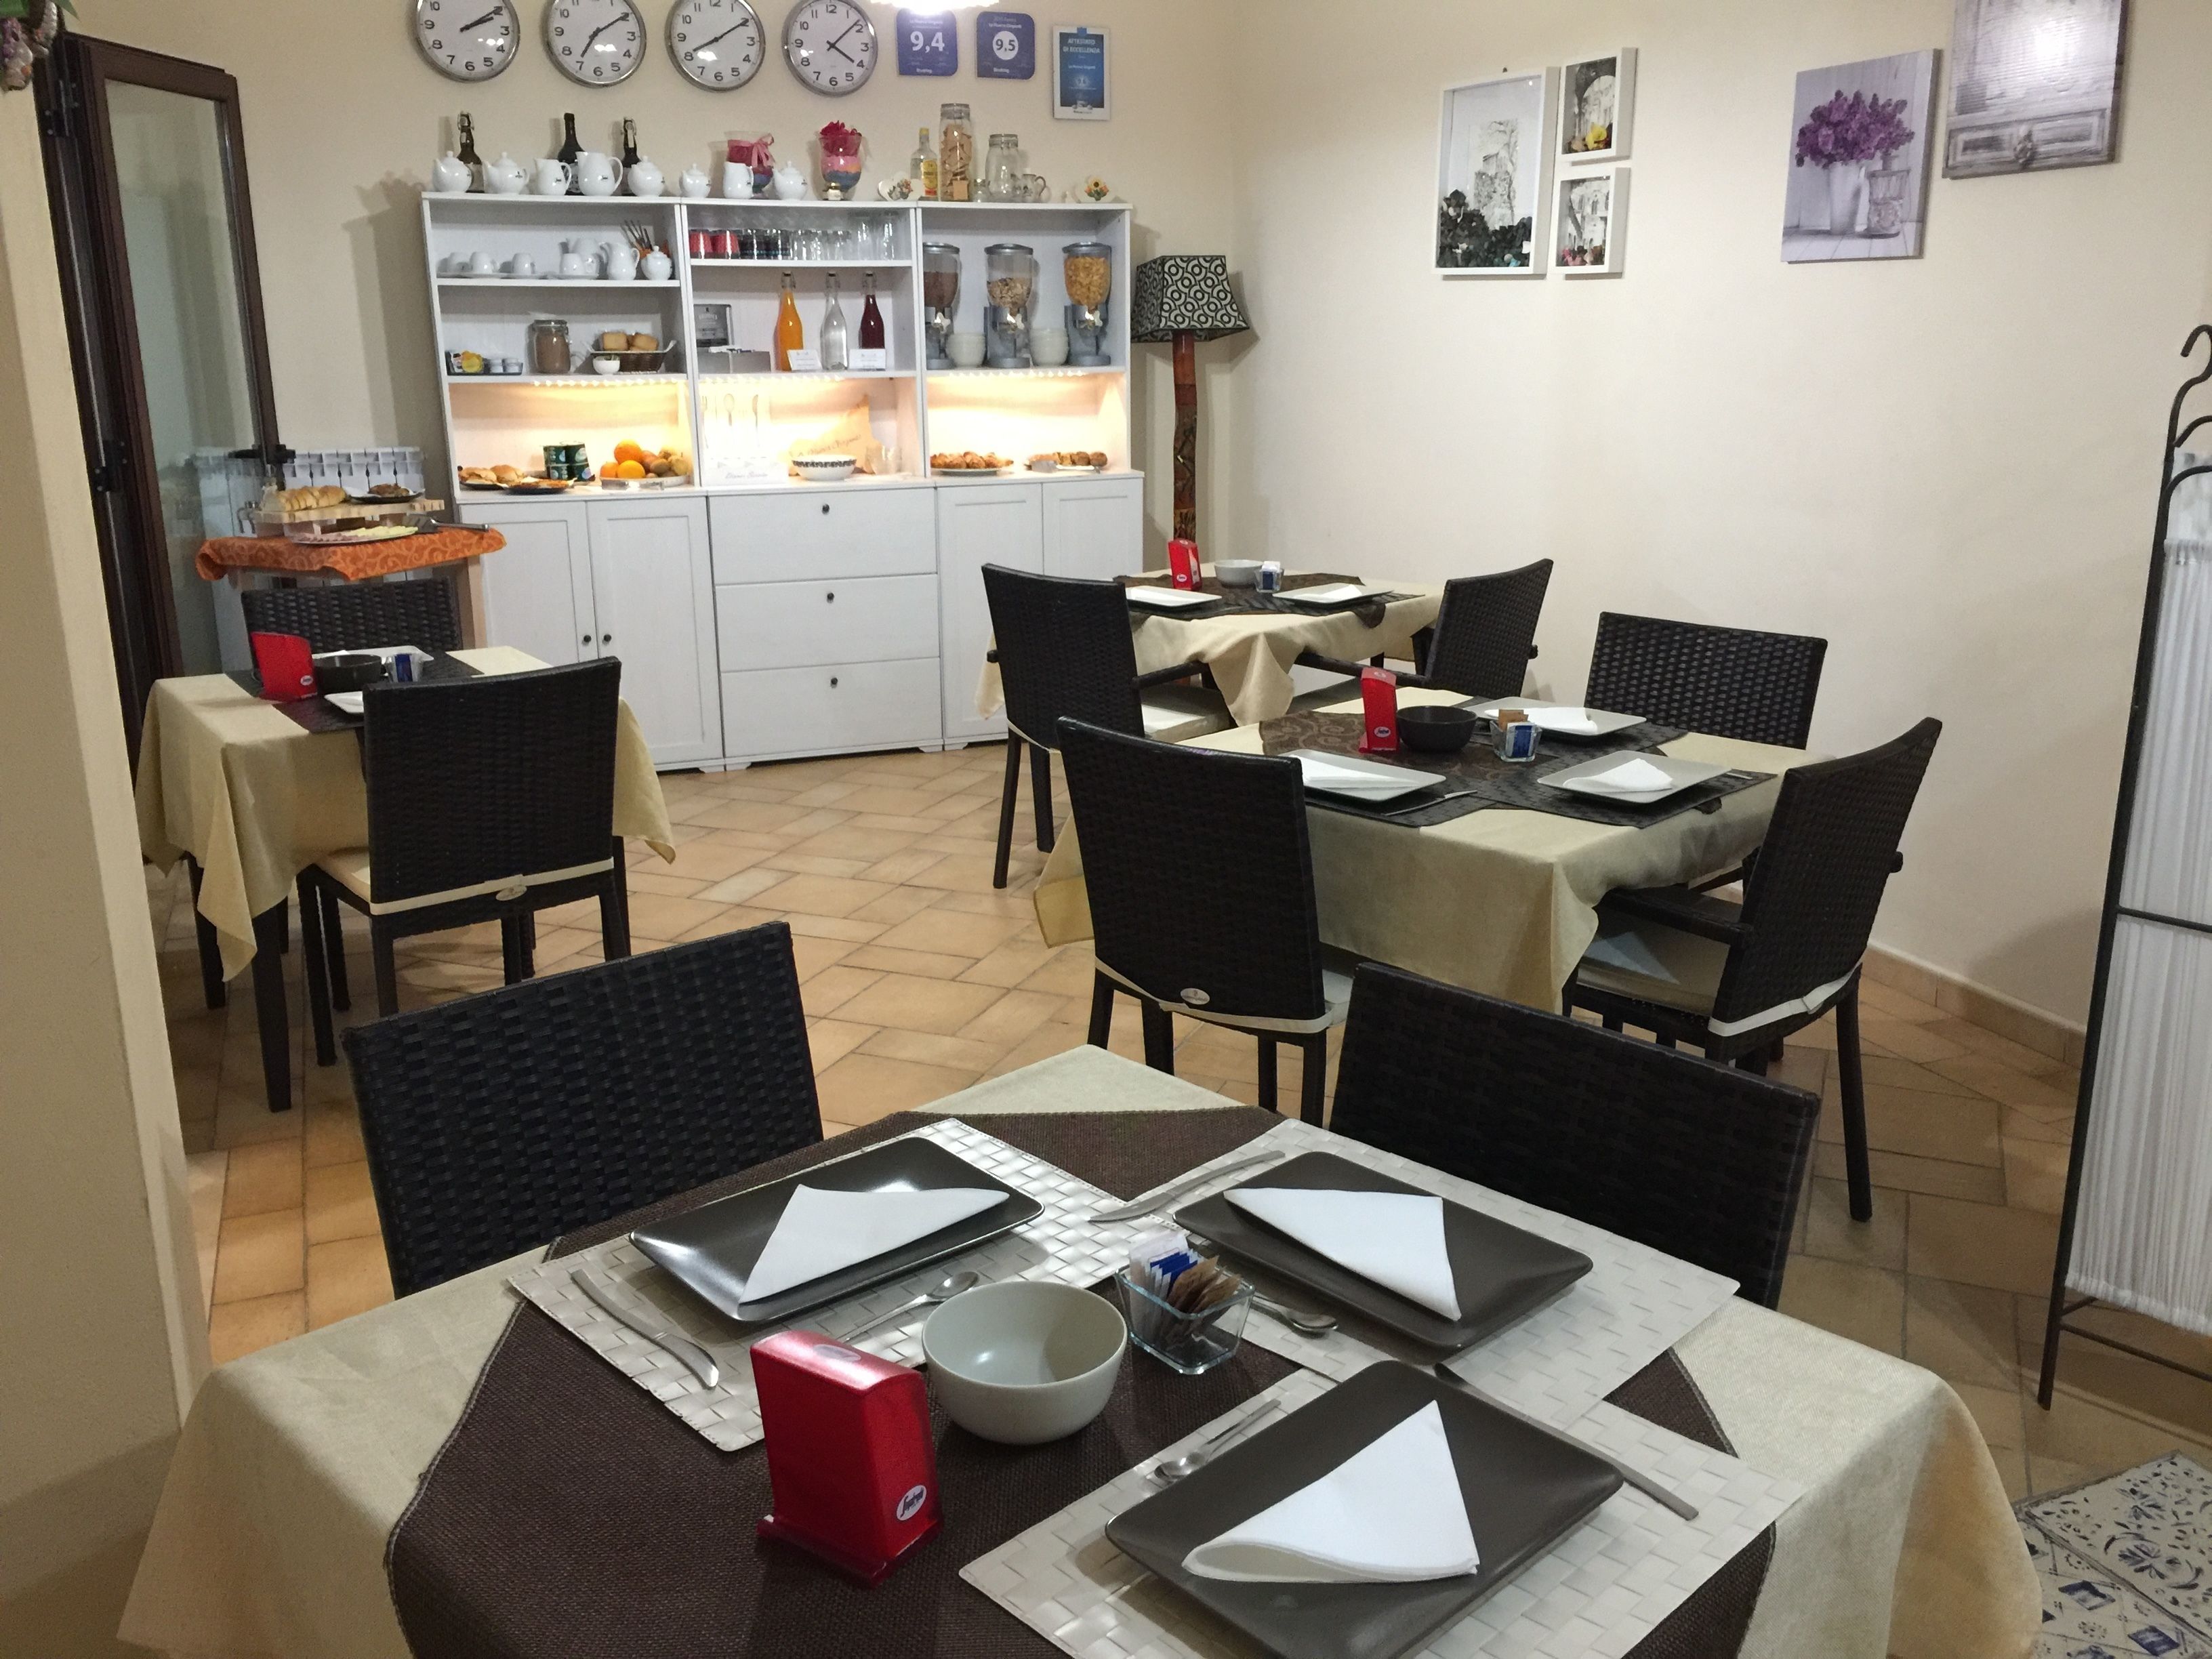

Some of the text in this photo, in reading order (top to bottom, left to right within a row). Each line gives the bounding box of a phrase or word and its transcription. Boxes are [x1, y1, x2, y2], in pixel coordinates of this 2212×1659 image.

[430, 1, 440, 11] 10
[694, 3, 701, 12] 11
[731, 3, 734, 12] 1
[826, 4, 837, 14] 12
[560, 9, 569, 18] 10
[811, 9, 818, 18] 11
[846, 9, 849, 19] 1
[682, 15, 691, 24] 10
[424, 20, 434, 29] 9
[800, 21, 808, 30] 10
[855, 24, 863, 33] 2
[500, 26, 510, 35] 3
[554, 26, 564, 36] 9
[627, 31, 636, 41] 3
[677, 33, 687, 42] 9
[432, 39, 443, 49] 8
[747, 37, 756, 46] 3
[794, 39, 804, 48] 9
[910, 30, 945, 54] 9,4
[496, 43, 505, 53] 4
[562, 46, 572, 56] 8
[861, 43, 869, 52] 3
[623, 49, 632, 58] 4
[684, 52, 694, 61] 8
[447, 54, 455, 64] 7
[483, 57, 493, 67] 5
[742, 54, 751, 63] 4
[800, 57, 810, 66] 8
[465, 61, 475, 71] 6
[576, 60, 584, 70] 7
[611, 62, 620, 72] 5
[856, 60, 865, 68] 4
[593, 66, 603, 76] 6
[697, 66, 705, 75] 7
[731, 67, 740, 77] 5
[714, 72, 723, 81] 6
[813, 71, 821, 81] 7
[845, 73, 854, 82] 5
[829, 77, 838, 86] 6
